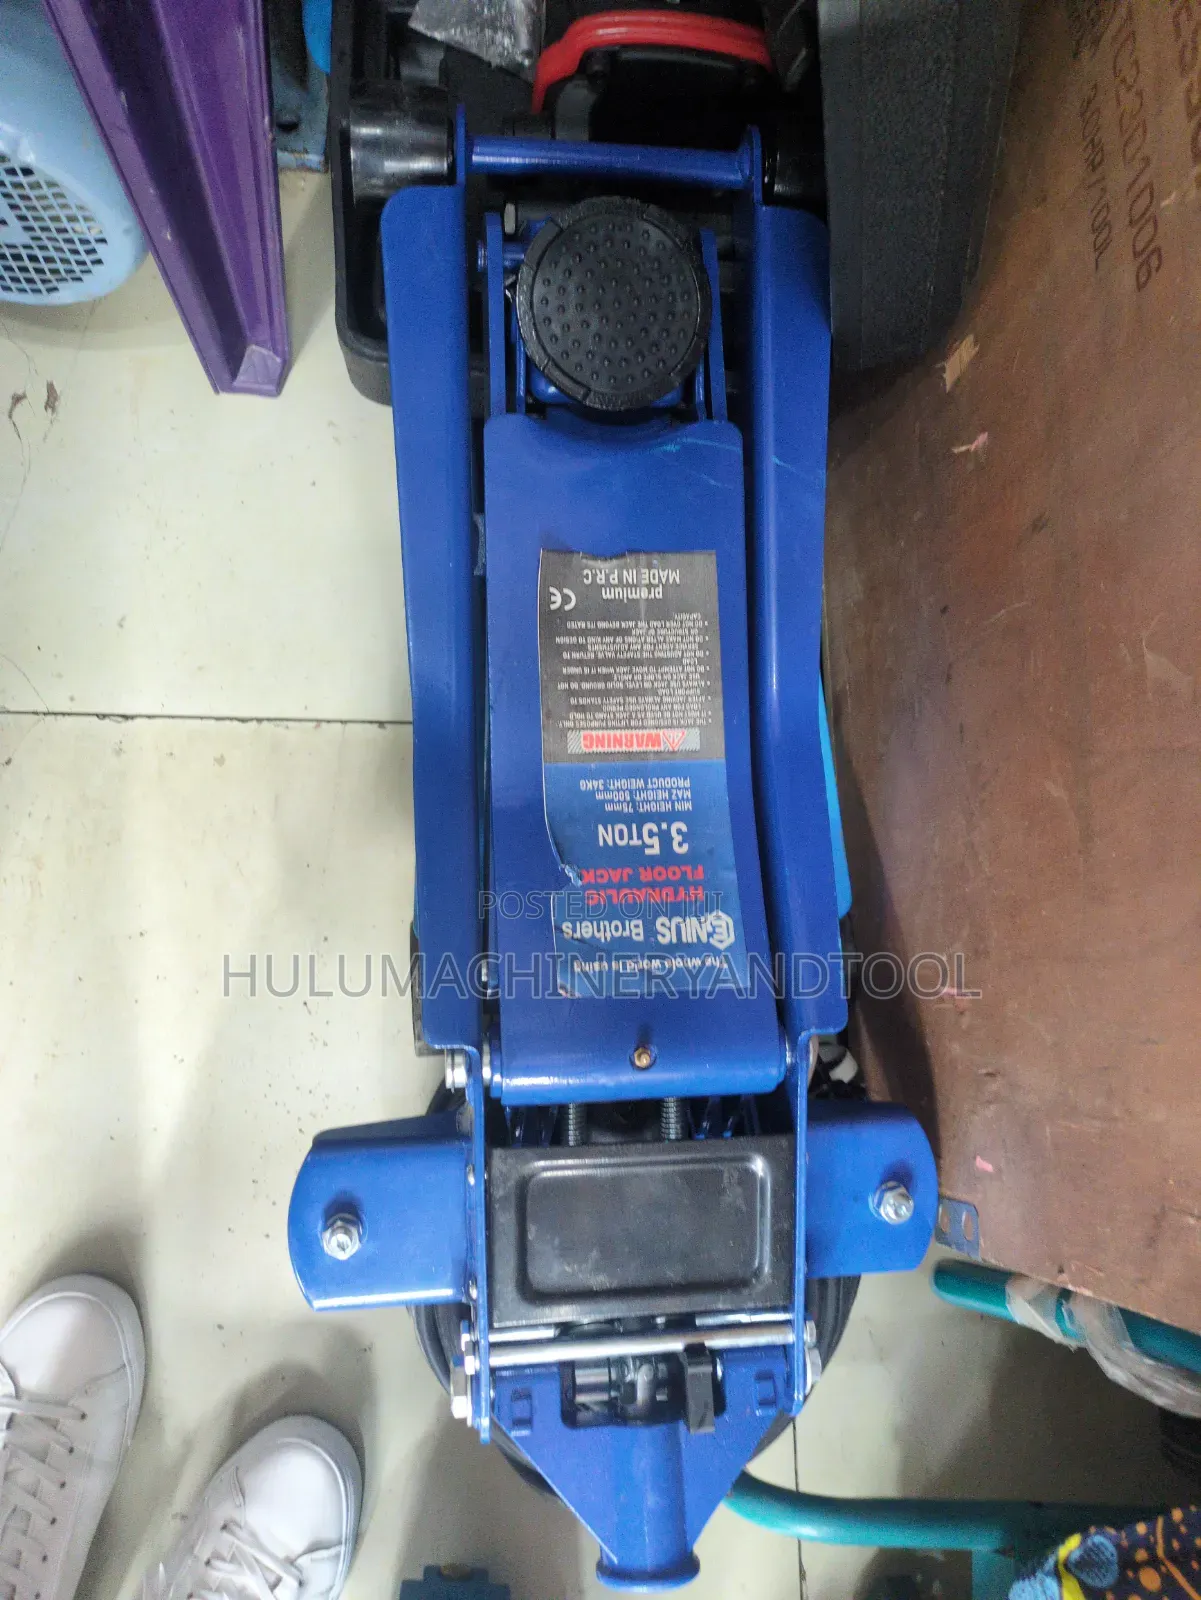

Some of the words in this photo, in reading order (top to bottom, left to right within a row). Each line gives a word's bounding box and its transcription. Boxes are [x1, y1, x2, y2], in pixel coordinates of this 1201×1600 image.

[583, 569, 618, 584] P.R.C
[623, 569, 637, 584] IN
[641, 569, 680, 584] MADE
[549, 586, 576, 611] CE
[602, 584, 662, 603] premium
[582, 732, 661, 750] WARNING
[580, 779, 604, 790] 34KG
[606, 778, 644, 789] WEIGHT:
[646, 776, 690, 788] PRODUCT
[595, 790, 630, 801] 500mm
[633, 789, 668, 800] HEIGHT:
[671, 788, 691, 800] MAZ
[604, 802, 633, 812] 75mm
[636, 801, 671, 812] HEIGHT:
[675, 800, 692, 811] MIN
[597, 821, 688, 855] 3.5TON
[580, 868, 633, 884] JACK
[640, 864, 704, 882] FLOOR
[584, 885, 704, 905] HYDRAULIC
[562, 919, 644, 943] Brothers
[574, 960, 608, 973] using
[612, 961, 622, 973] is
[627, 958, 661, 972] world
[665, 957, 701, 969] whole
[705, 955, 728, 967] The
